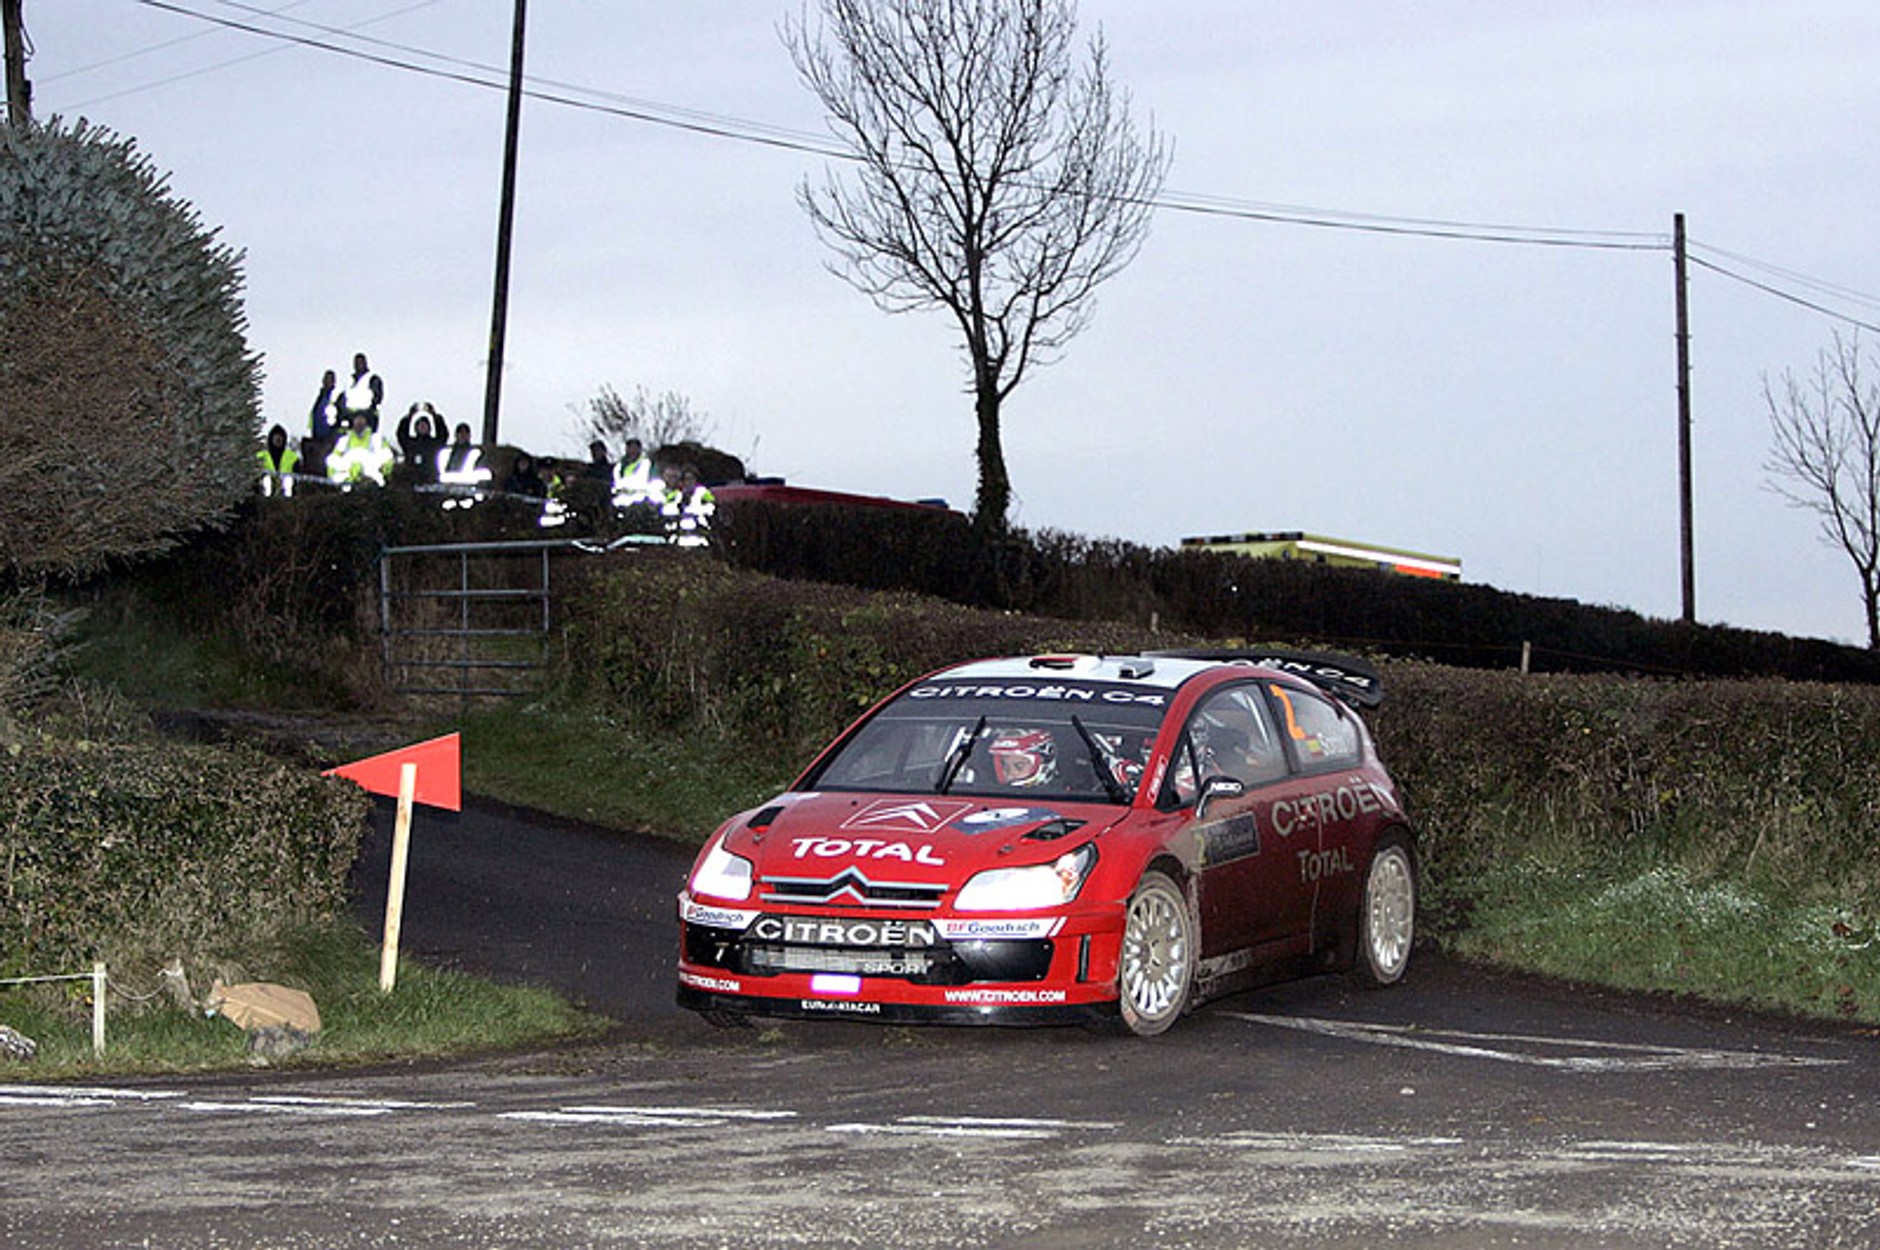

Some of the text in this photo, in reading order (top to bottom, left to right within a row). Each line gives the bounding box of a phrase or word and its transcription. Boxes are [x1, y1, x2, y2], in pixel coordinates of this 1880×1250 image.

[909, 685, 1166, 706] CITROËN C4
[791, 836, 946, 867] TOTAL
[1297, 846, 1354, 884] TOTAL
[755, 918, 935, 946] CITROËN
